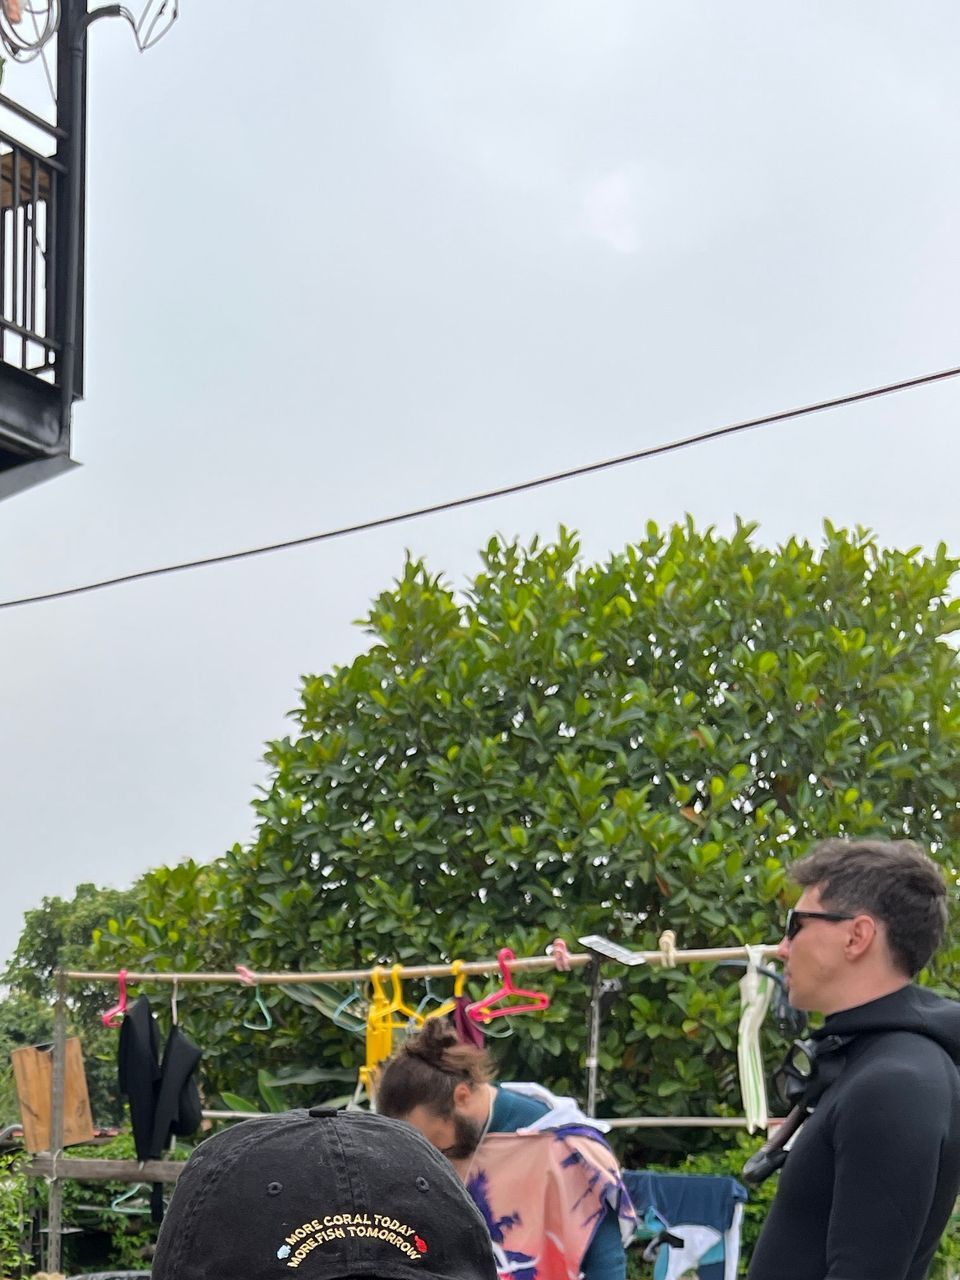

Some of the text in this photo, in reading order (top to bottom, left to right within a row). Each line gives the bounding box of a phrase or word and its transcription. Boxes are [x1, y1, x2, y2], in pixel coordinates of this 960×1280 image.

[285, 1213, 416, 1245] MORE CORAL TODAY
[286, 1226, 422, 1268] MORE FISH TOMORROW
